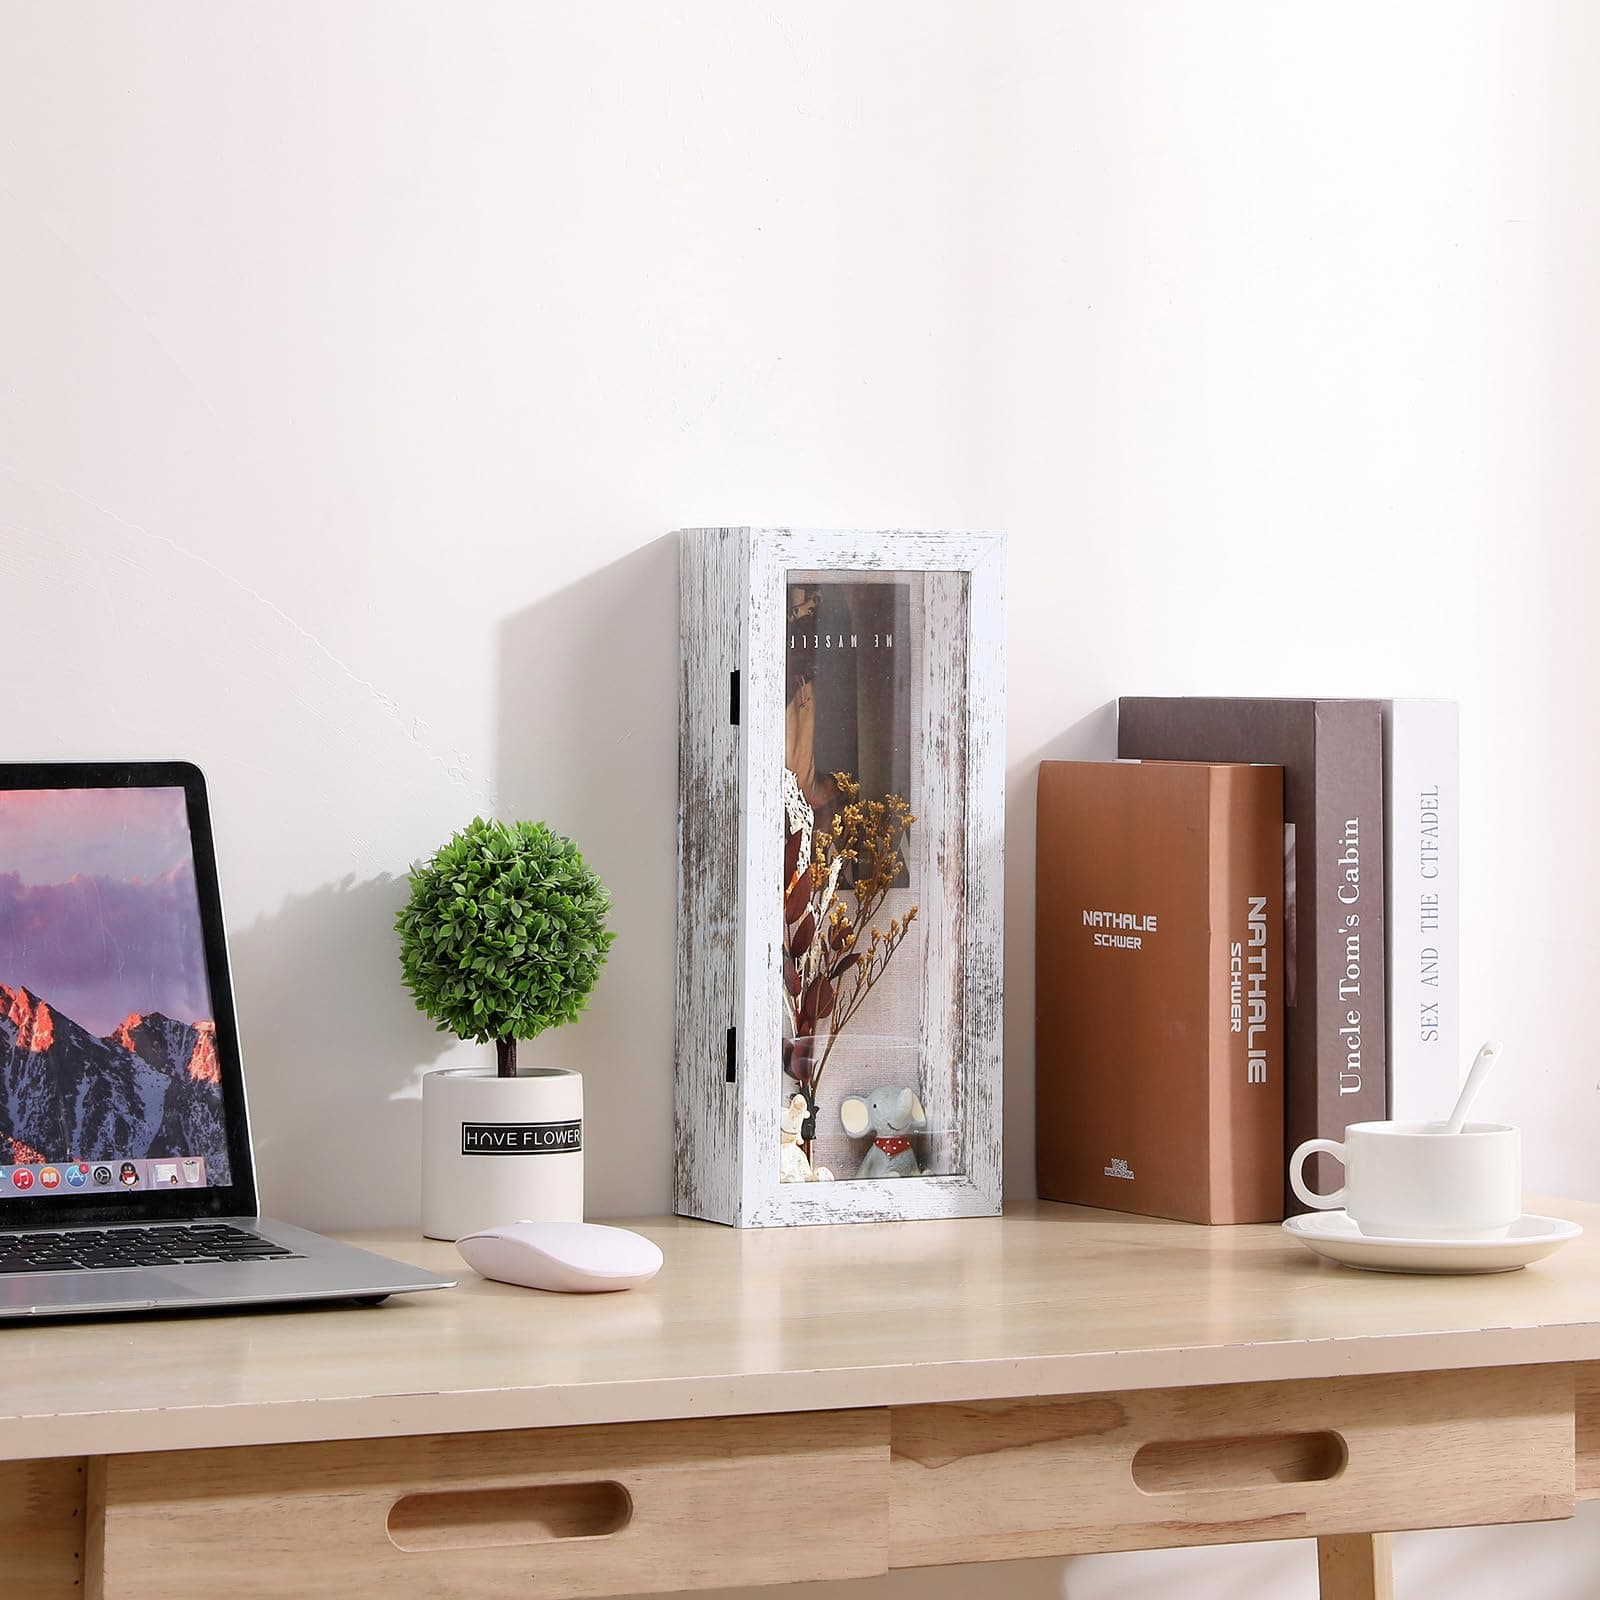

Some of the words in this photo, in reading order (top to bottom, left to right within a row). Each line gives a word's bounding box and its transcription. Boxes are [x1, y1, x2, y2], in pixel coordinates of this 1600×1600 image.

[874, 634, 893, 648] ME
[1420, 784, 1439, 880] CTFADEL
[1337, 815, 1360, 905] Cabin
[1082, 909, 1158, 933] NATHALIE
[1420, 893, 1439, 934] THE
[1093, 933, 1142, 950] SCHWER
[1338, 913, 1361, 1002] Tom's
[1230, 942, 1242, 1033] SCHWER
[1420, 947, 1439, 988] AND
[1247, 896, 1267, 1084] NATHALIE
[1421, 1002, 1439, 1042] SEX
[1338, 1009, 1362, 1097] Uncle
[466, 1131, 518, 1146] HAVE
